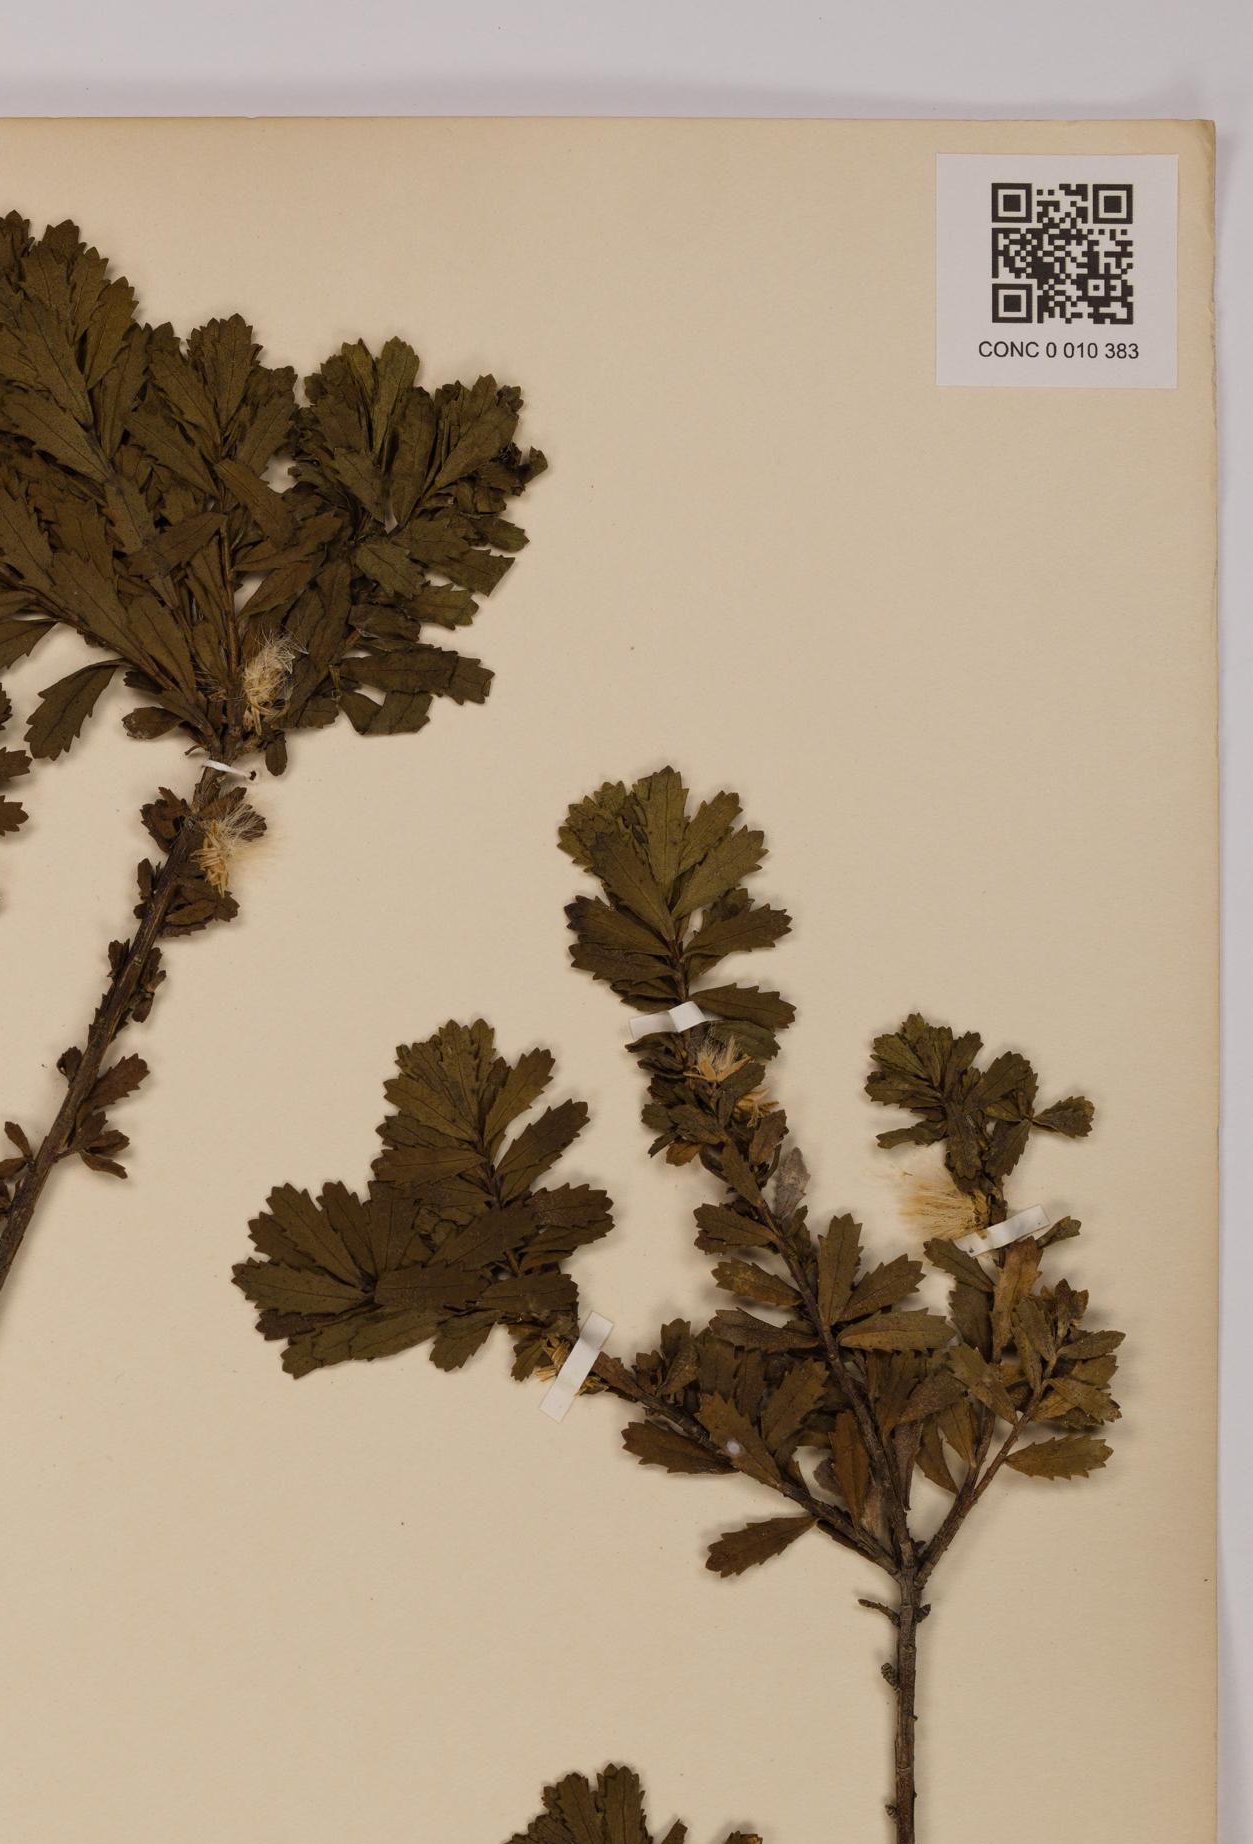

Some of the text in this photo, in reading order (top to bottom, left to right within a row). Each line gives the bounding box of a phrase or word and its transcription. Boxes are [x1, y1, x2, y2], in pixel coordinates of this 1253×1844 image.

[978, 340, 1140, 360] CONC 0 010 383
